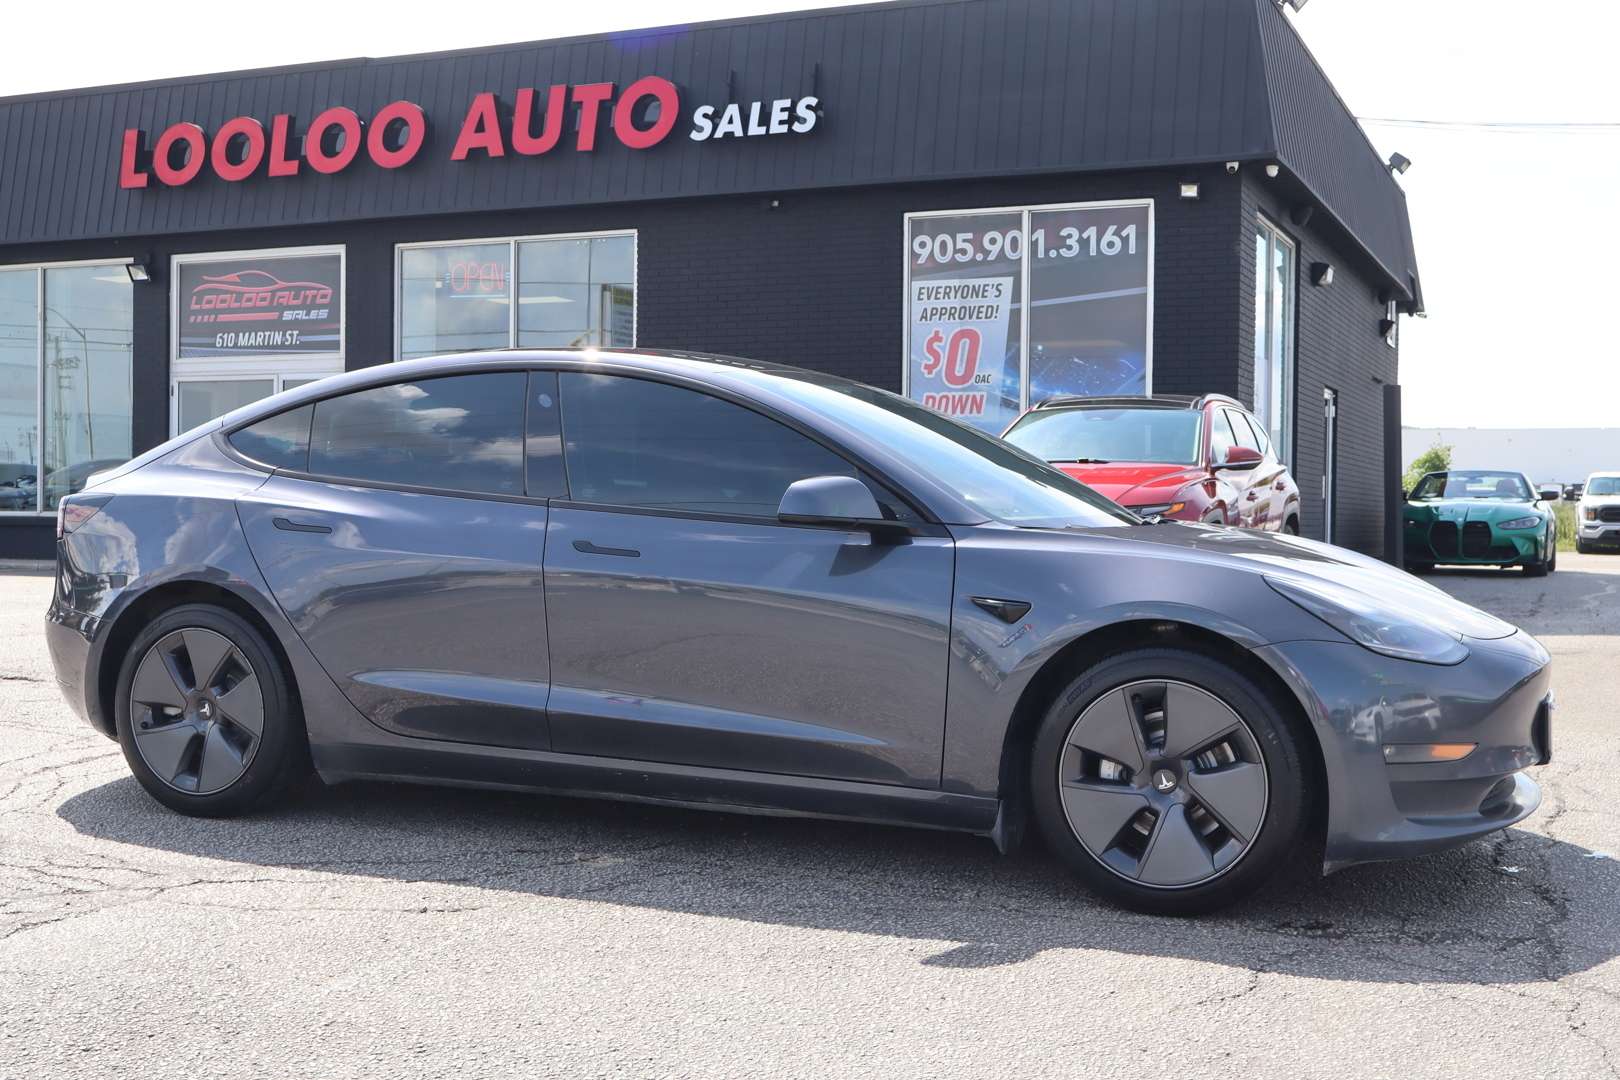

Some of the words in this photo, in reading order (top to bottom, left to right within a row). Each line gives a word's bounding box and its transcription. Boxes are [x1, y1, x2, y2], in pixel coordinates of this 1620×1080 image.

[120, 100, 426, 189] LOOLOO
[450, 75, 680, 161] AUTO
[689, 96, 819, 142] SALES
[912, 224, 1137, 265] 905.901.3161
[451, 261, 504, 292] OPEN
[190, 292, 272, 310] LOOLOO
[273, 289, 333, 306] AUTO
[917, 283, 1003, 301] EVERYONE'S
[282, 309, 329, 321] SALES
[919, 305, 1000, 322] APPROVED!
[215, 332, 235, 347] 610
[237, 331, 283, 347] MARTIN
[283, 330, 300, 345] ST.
[923, 328, 981, 386] $0
[974, 373, 992, 385] OAC
[924, 394, 985, 415] DOWN
